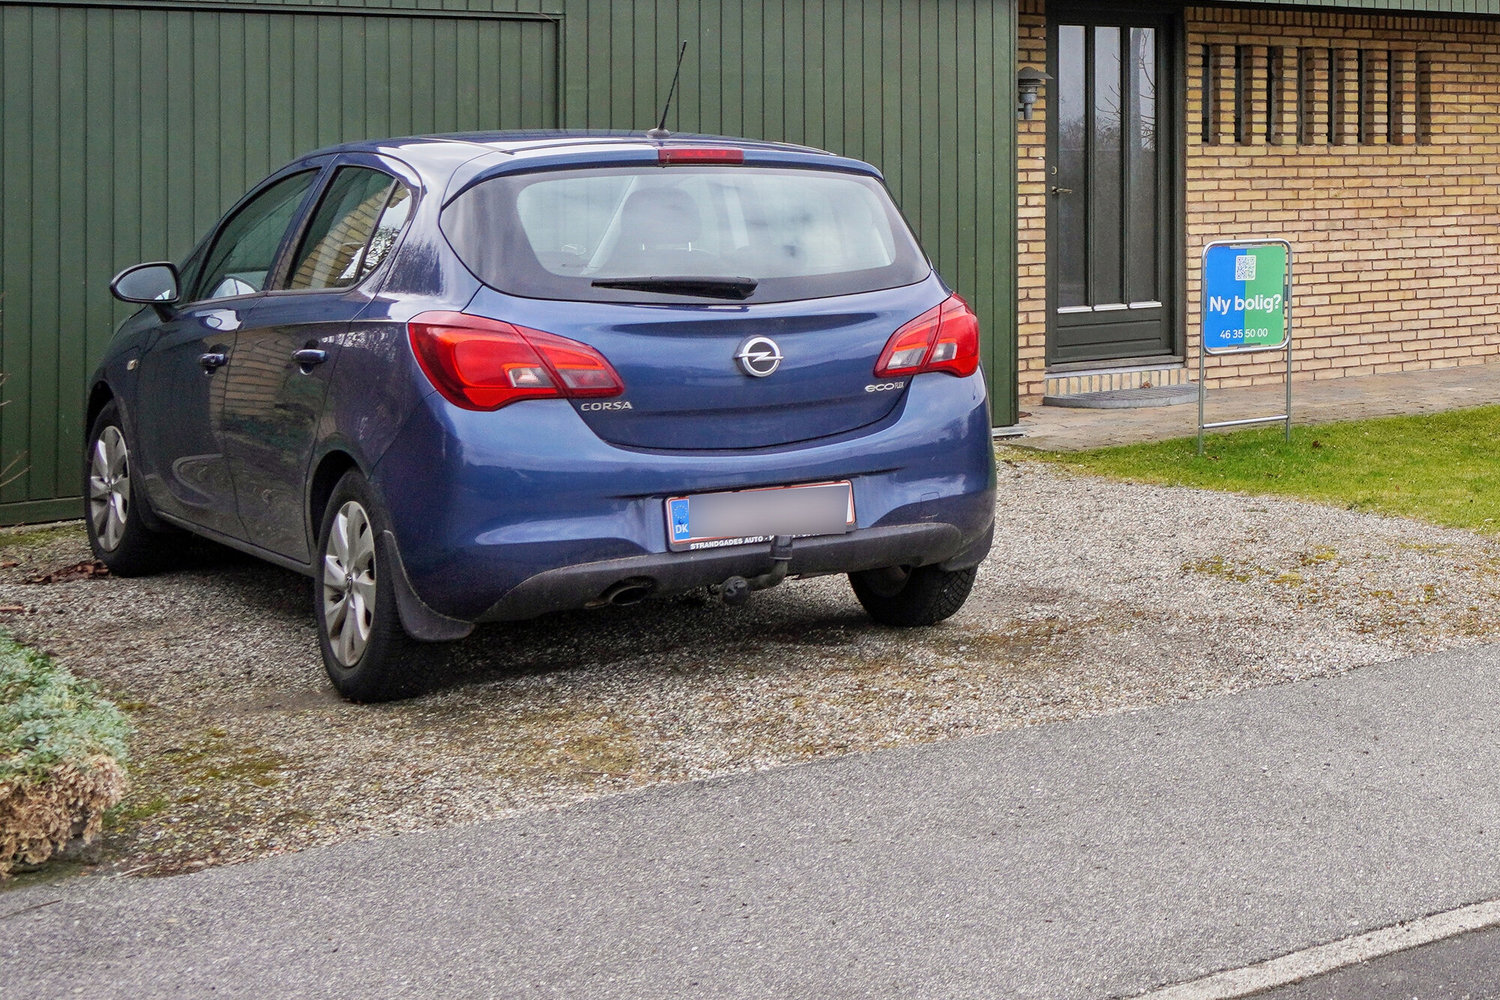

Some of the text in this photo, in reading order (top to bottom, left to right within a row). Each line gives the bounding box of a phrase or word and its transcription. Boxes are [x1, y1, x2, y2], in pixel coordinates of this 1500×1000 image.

[1209, 294, 1282, 315] Ny bolig?
[1220, 328, 1268, 339] 46 35 50 00
[580, 401, 633, 411] CORSA
[675, 524, 689, 534] DK
[690, 539, 743, 550] STRANDGADES
[744, 536, 763, 545] AUTO
